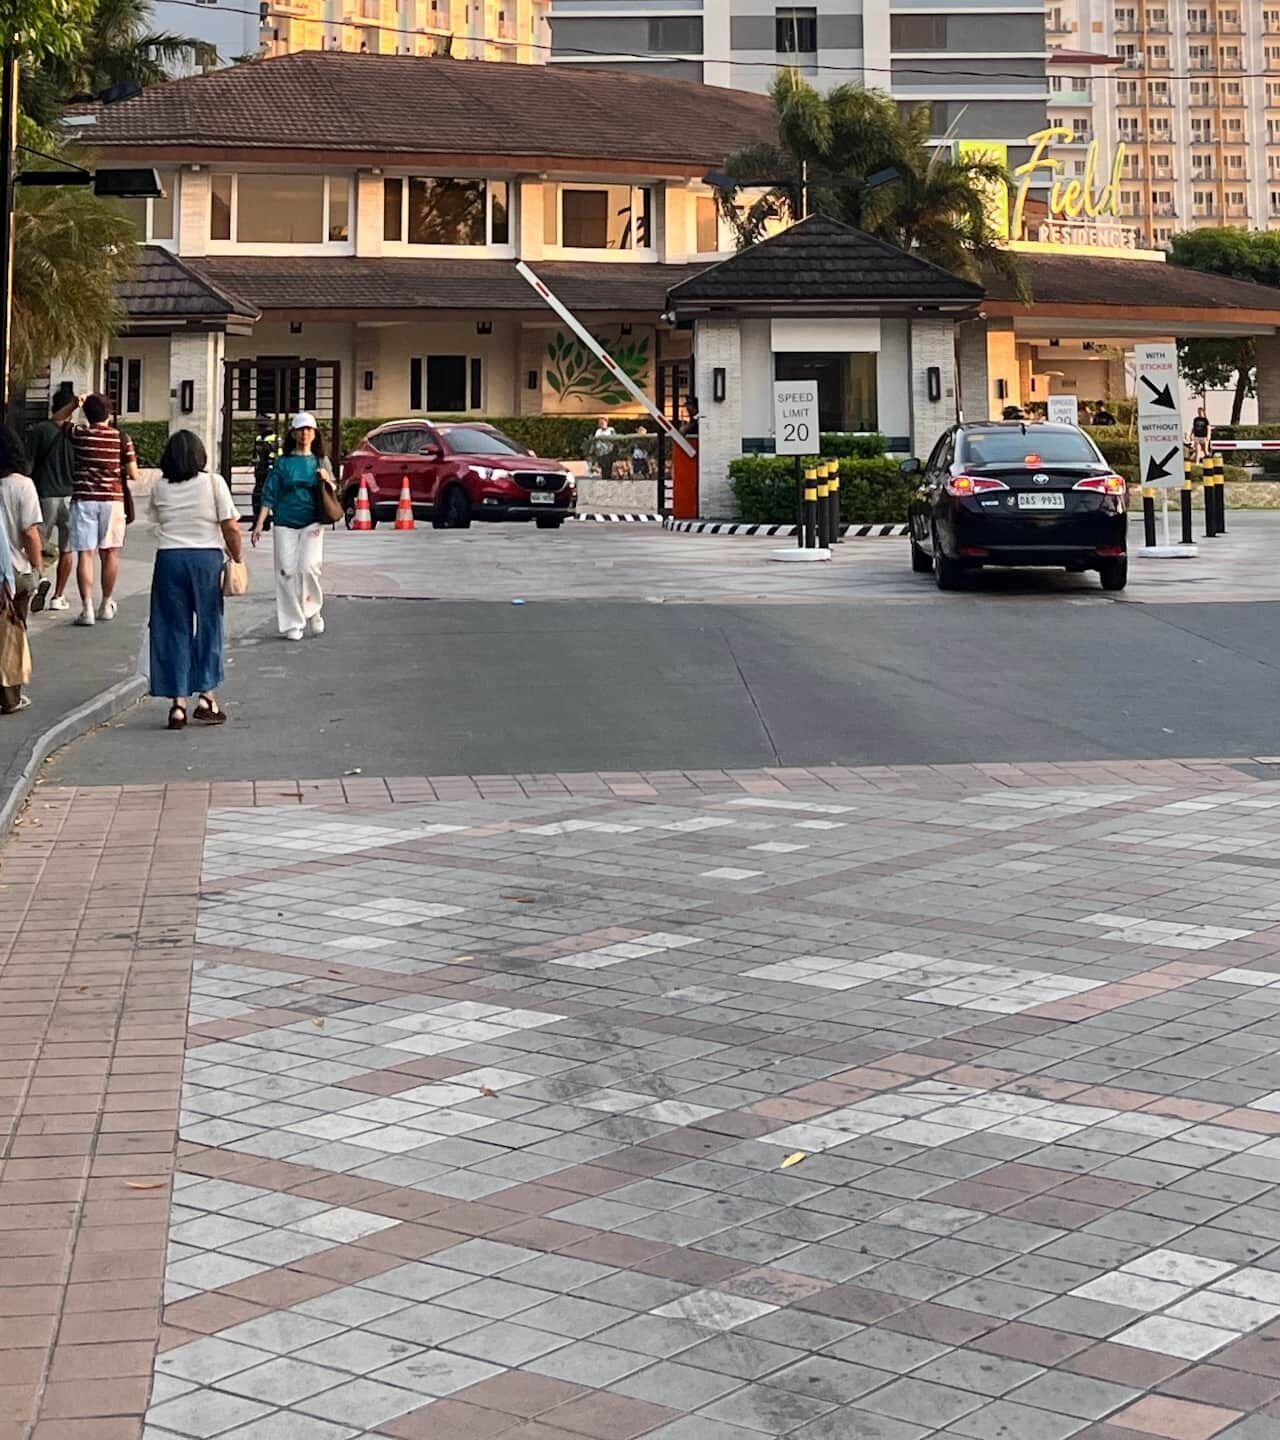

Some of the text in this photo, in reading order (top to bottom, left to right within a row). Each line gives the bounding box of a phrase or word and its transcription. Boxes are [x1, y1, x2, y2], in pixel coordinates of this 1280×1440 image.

[1011, 127, 1126, 241] Field
[1038, 224, 1137, 250] RESIDENCES
[1145, 351, 1166, 360] WITH
[1139, 363, 1173, 371] STICKER
[777, 392, 815, 404] SPEED
[782, 407, 810, 419] LIMIT
[783, 423, 809, 442] 20
[1141, 423, 1179, 432] WITHOUT
